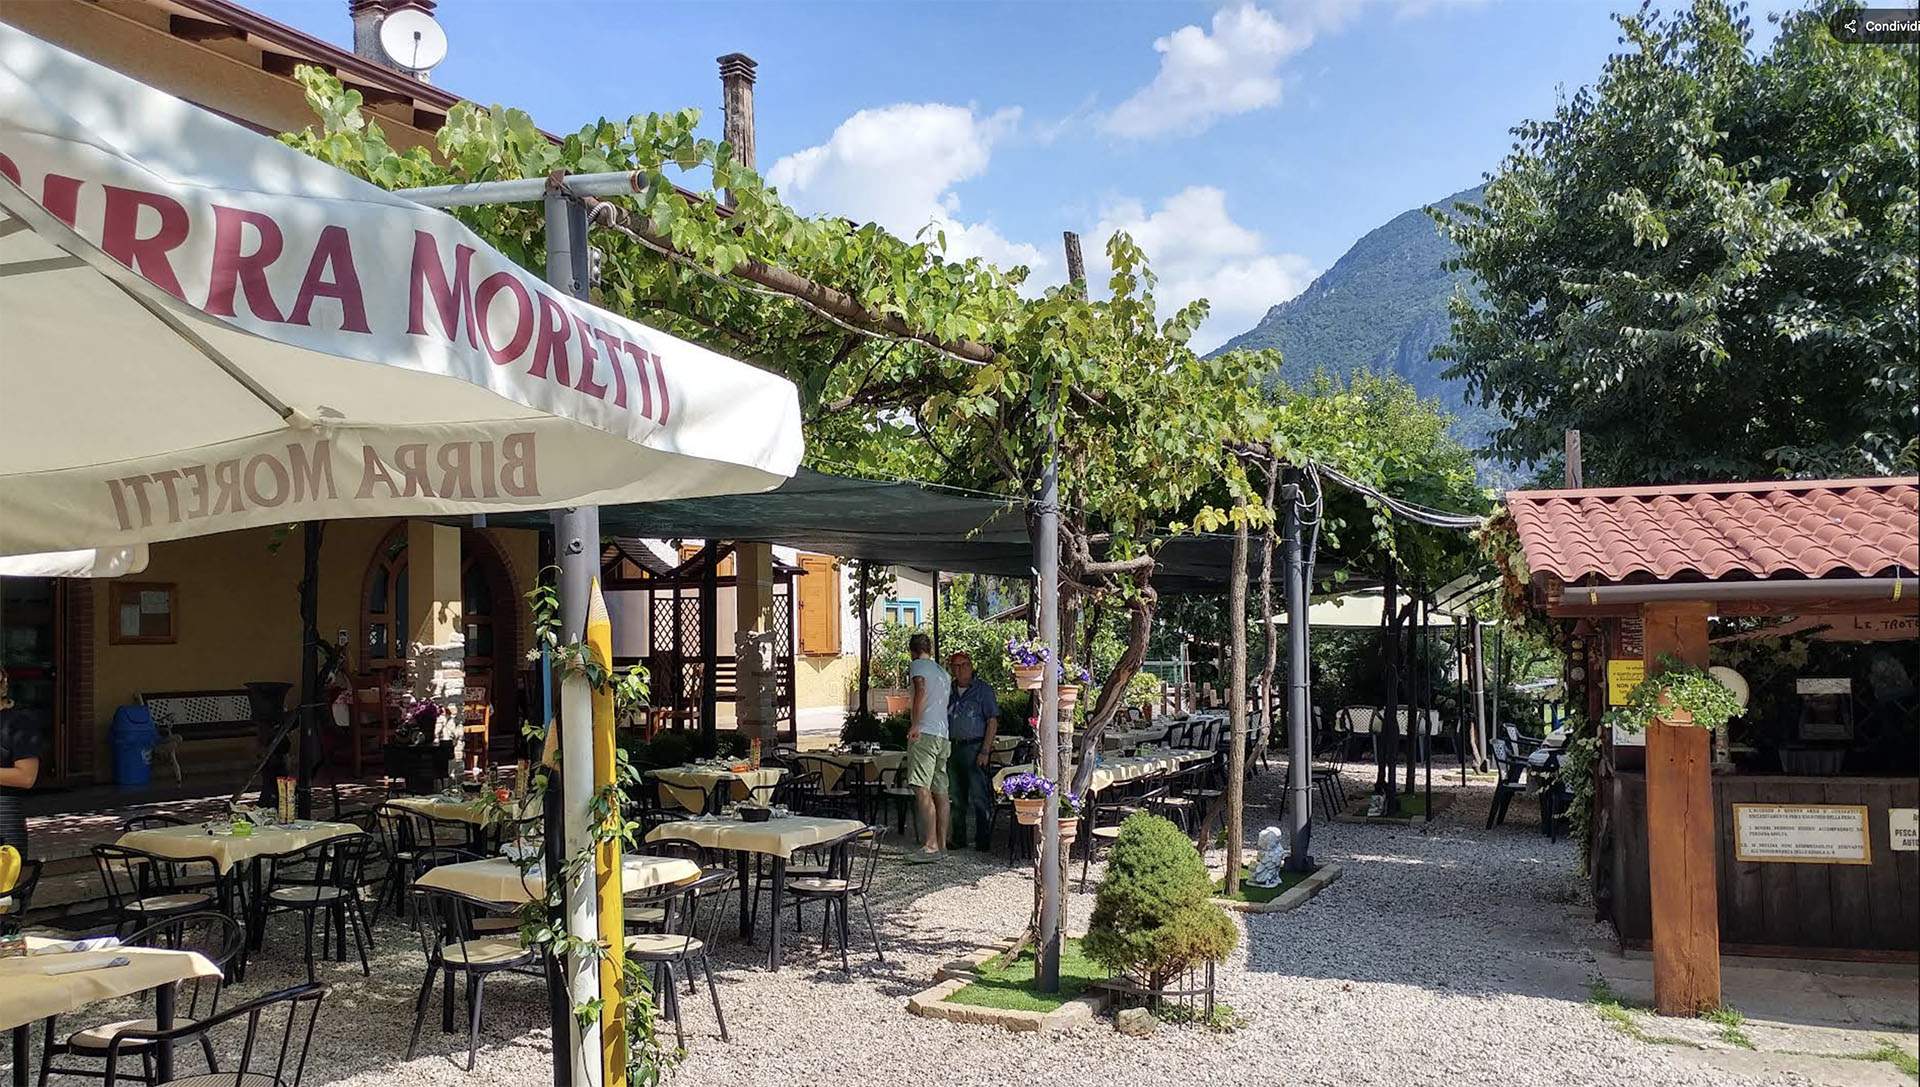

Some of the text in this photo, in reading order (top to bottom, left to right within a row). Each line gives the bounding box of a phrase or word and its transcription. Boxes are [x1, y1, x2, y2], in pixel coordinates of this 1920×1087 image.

[0, 152, 670, 427] RRA MORETTI
[1895, 829, 1917, 837] PESCA
